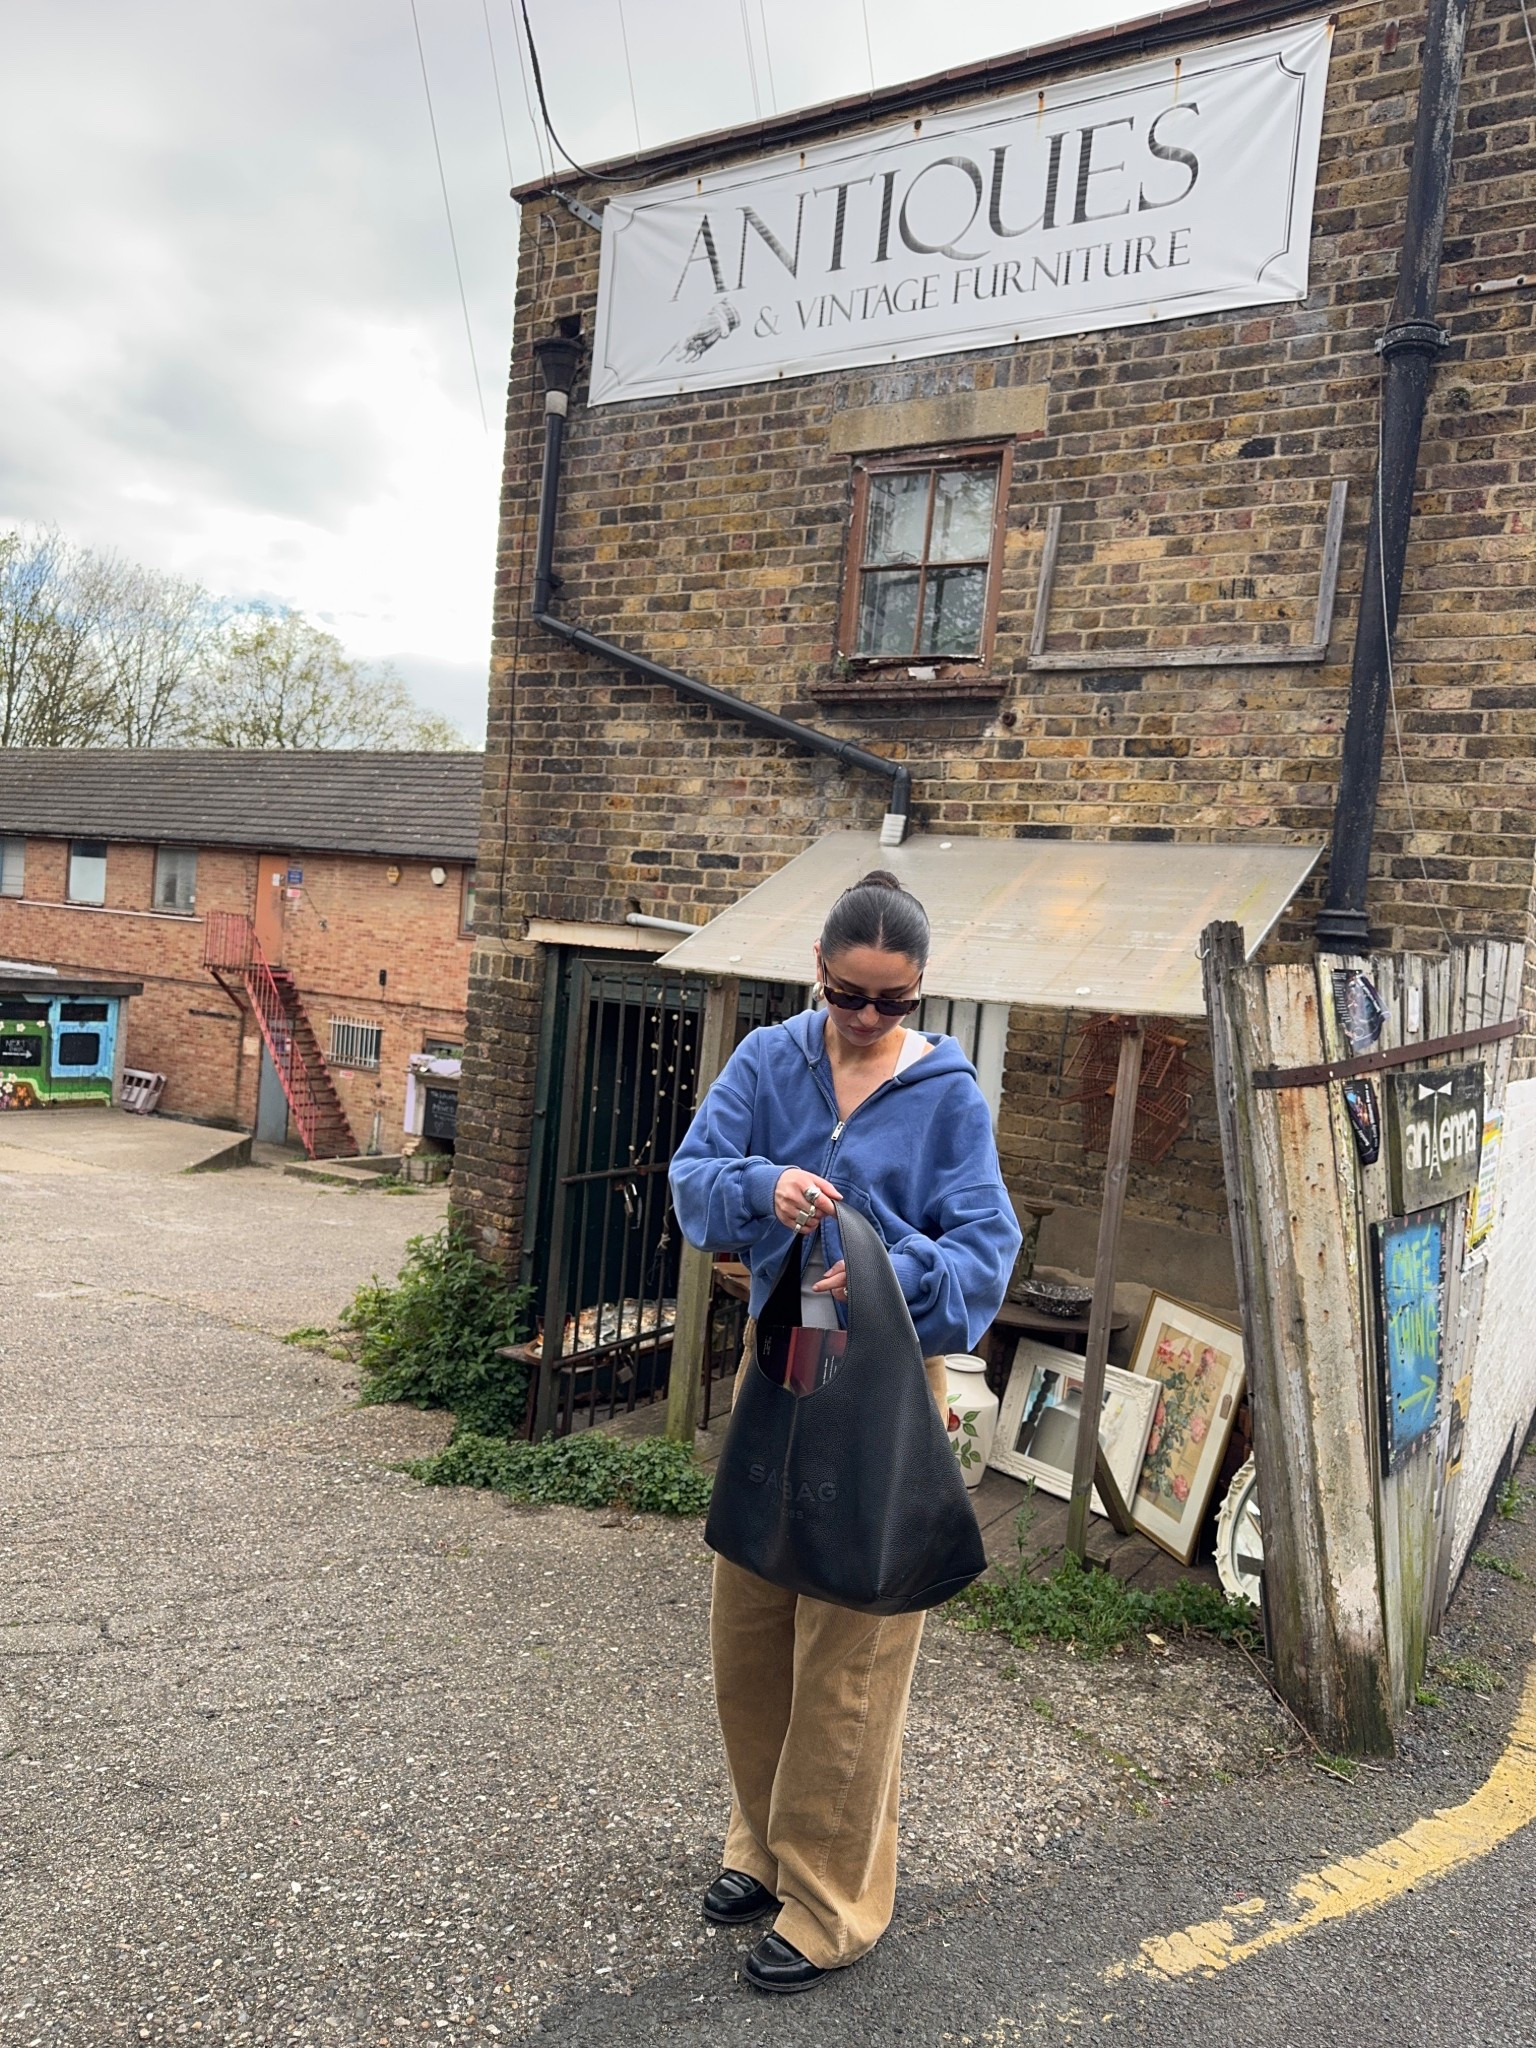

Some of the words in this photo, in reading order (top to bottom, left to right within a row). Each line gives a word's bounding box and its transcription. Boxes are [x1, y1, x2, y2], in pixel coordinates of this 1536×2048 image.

[669, 102, 1199, 303] ANTIQUES
[754, 306, 782, 338] &
[795, 274, 940, 330] VINTAGE
[952, 227, 1191, 304] FURNITURE
[1392, 1223, 1432, 1297] CAFÉ
[1390, 1299, 1438, 1367] THING
